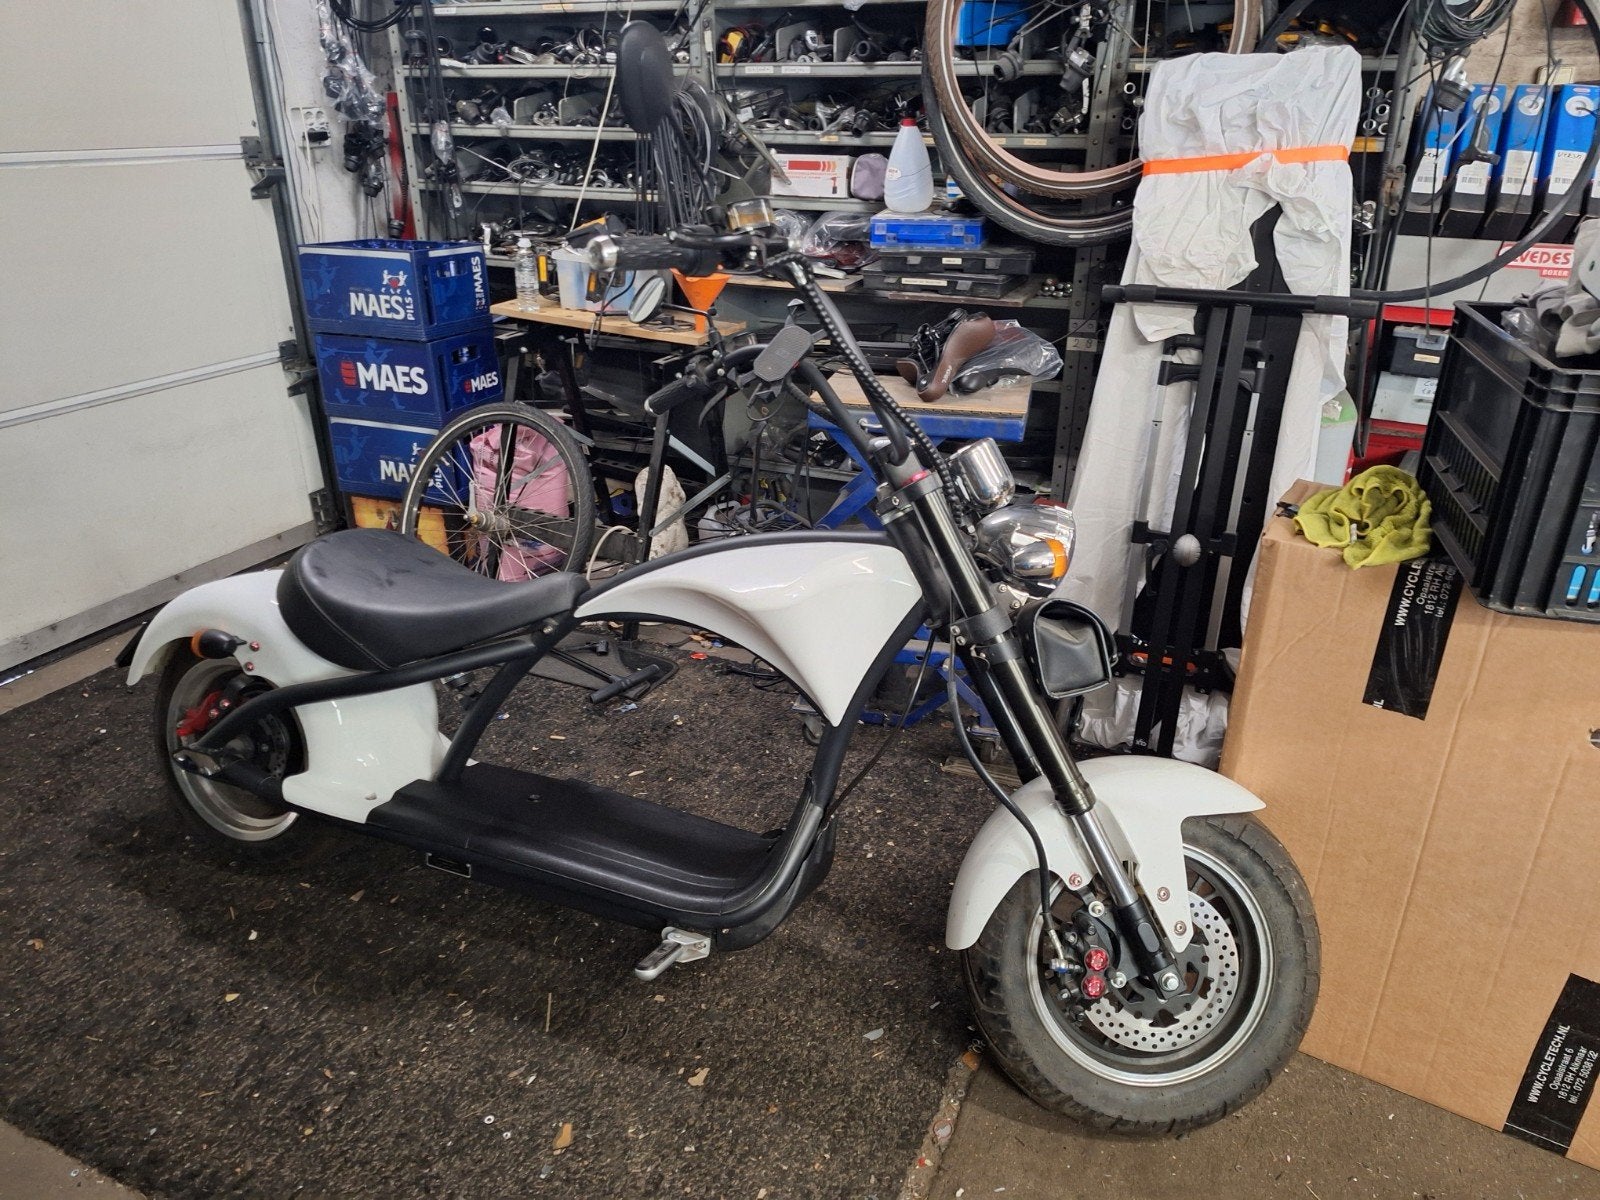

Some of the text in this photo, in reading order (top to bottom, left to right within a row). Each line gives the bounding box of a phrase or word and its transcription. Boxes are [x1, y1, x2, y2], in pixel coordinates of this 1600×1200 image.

[1513, 250, 1572, 265] VEDES
[471, 256, 484, 293] MAES
[1542, 269, 1569, 277] BOXER
[349, 291, 406, 320] MAES
[404, 296, 416, 320] PILS
[356, 361, 428, 395] MAES
[470, 371, 499, 393] MAES
[1429, 578, 1442, 592] RH
[1424, 594, 1438, 615] 1812
[1527, 1025, 1571, 1103] WWW.CYCLETECH.NL
[1549, 1053, 1572, 1090] Opaalstraat
[1557, 1045, 1588, 1100] 1812 RH Alkmaar
[1573, 1077, 1586, 1092] 072
